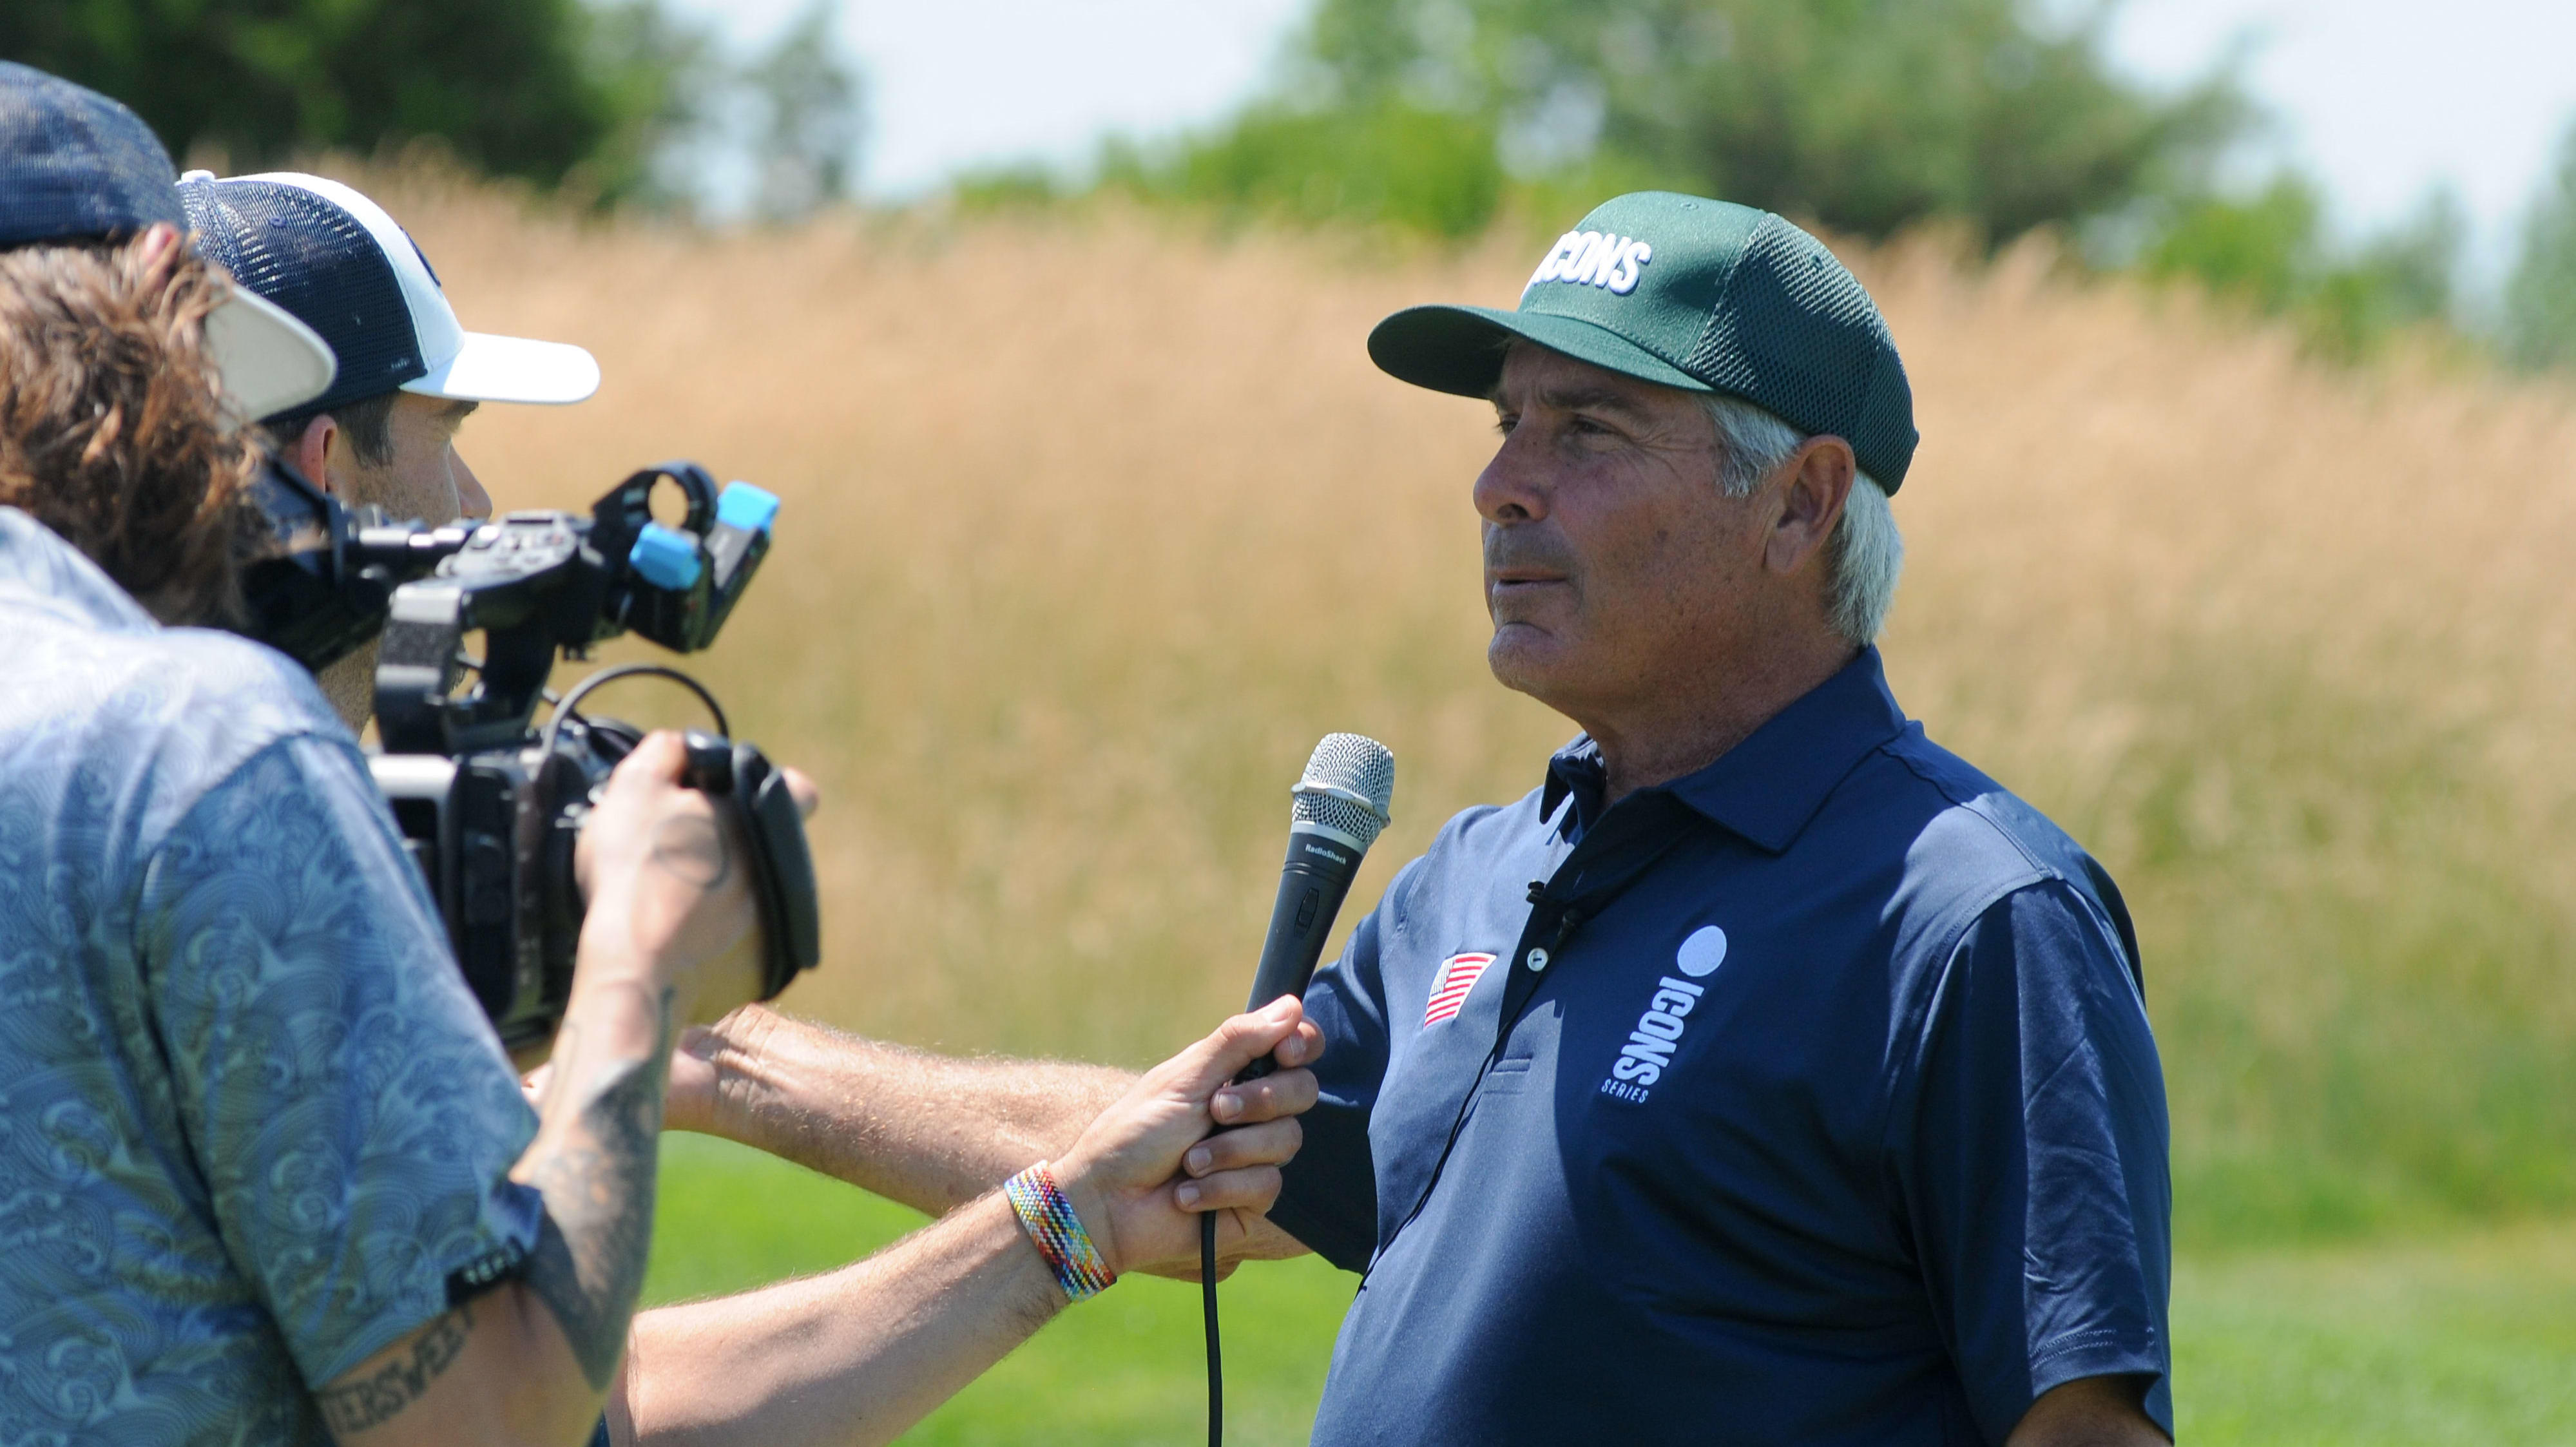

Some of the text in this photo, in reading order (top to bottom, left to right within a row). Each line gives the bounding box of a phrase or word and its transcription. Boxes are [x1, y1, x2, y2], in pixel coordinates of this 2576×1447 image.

[1305, 843, 1347, 865] RadioShack
[1613, 976, 1705, 1086] ICONS
[1601, 1078, 1649, 1104] SERIES
